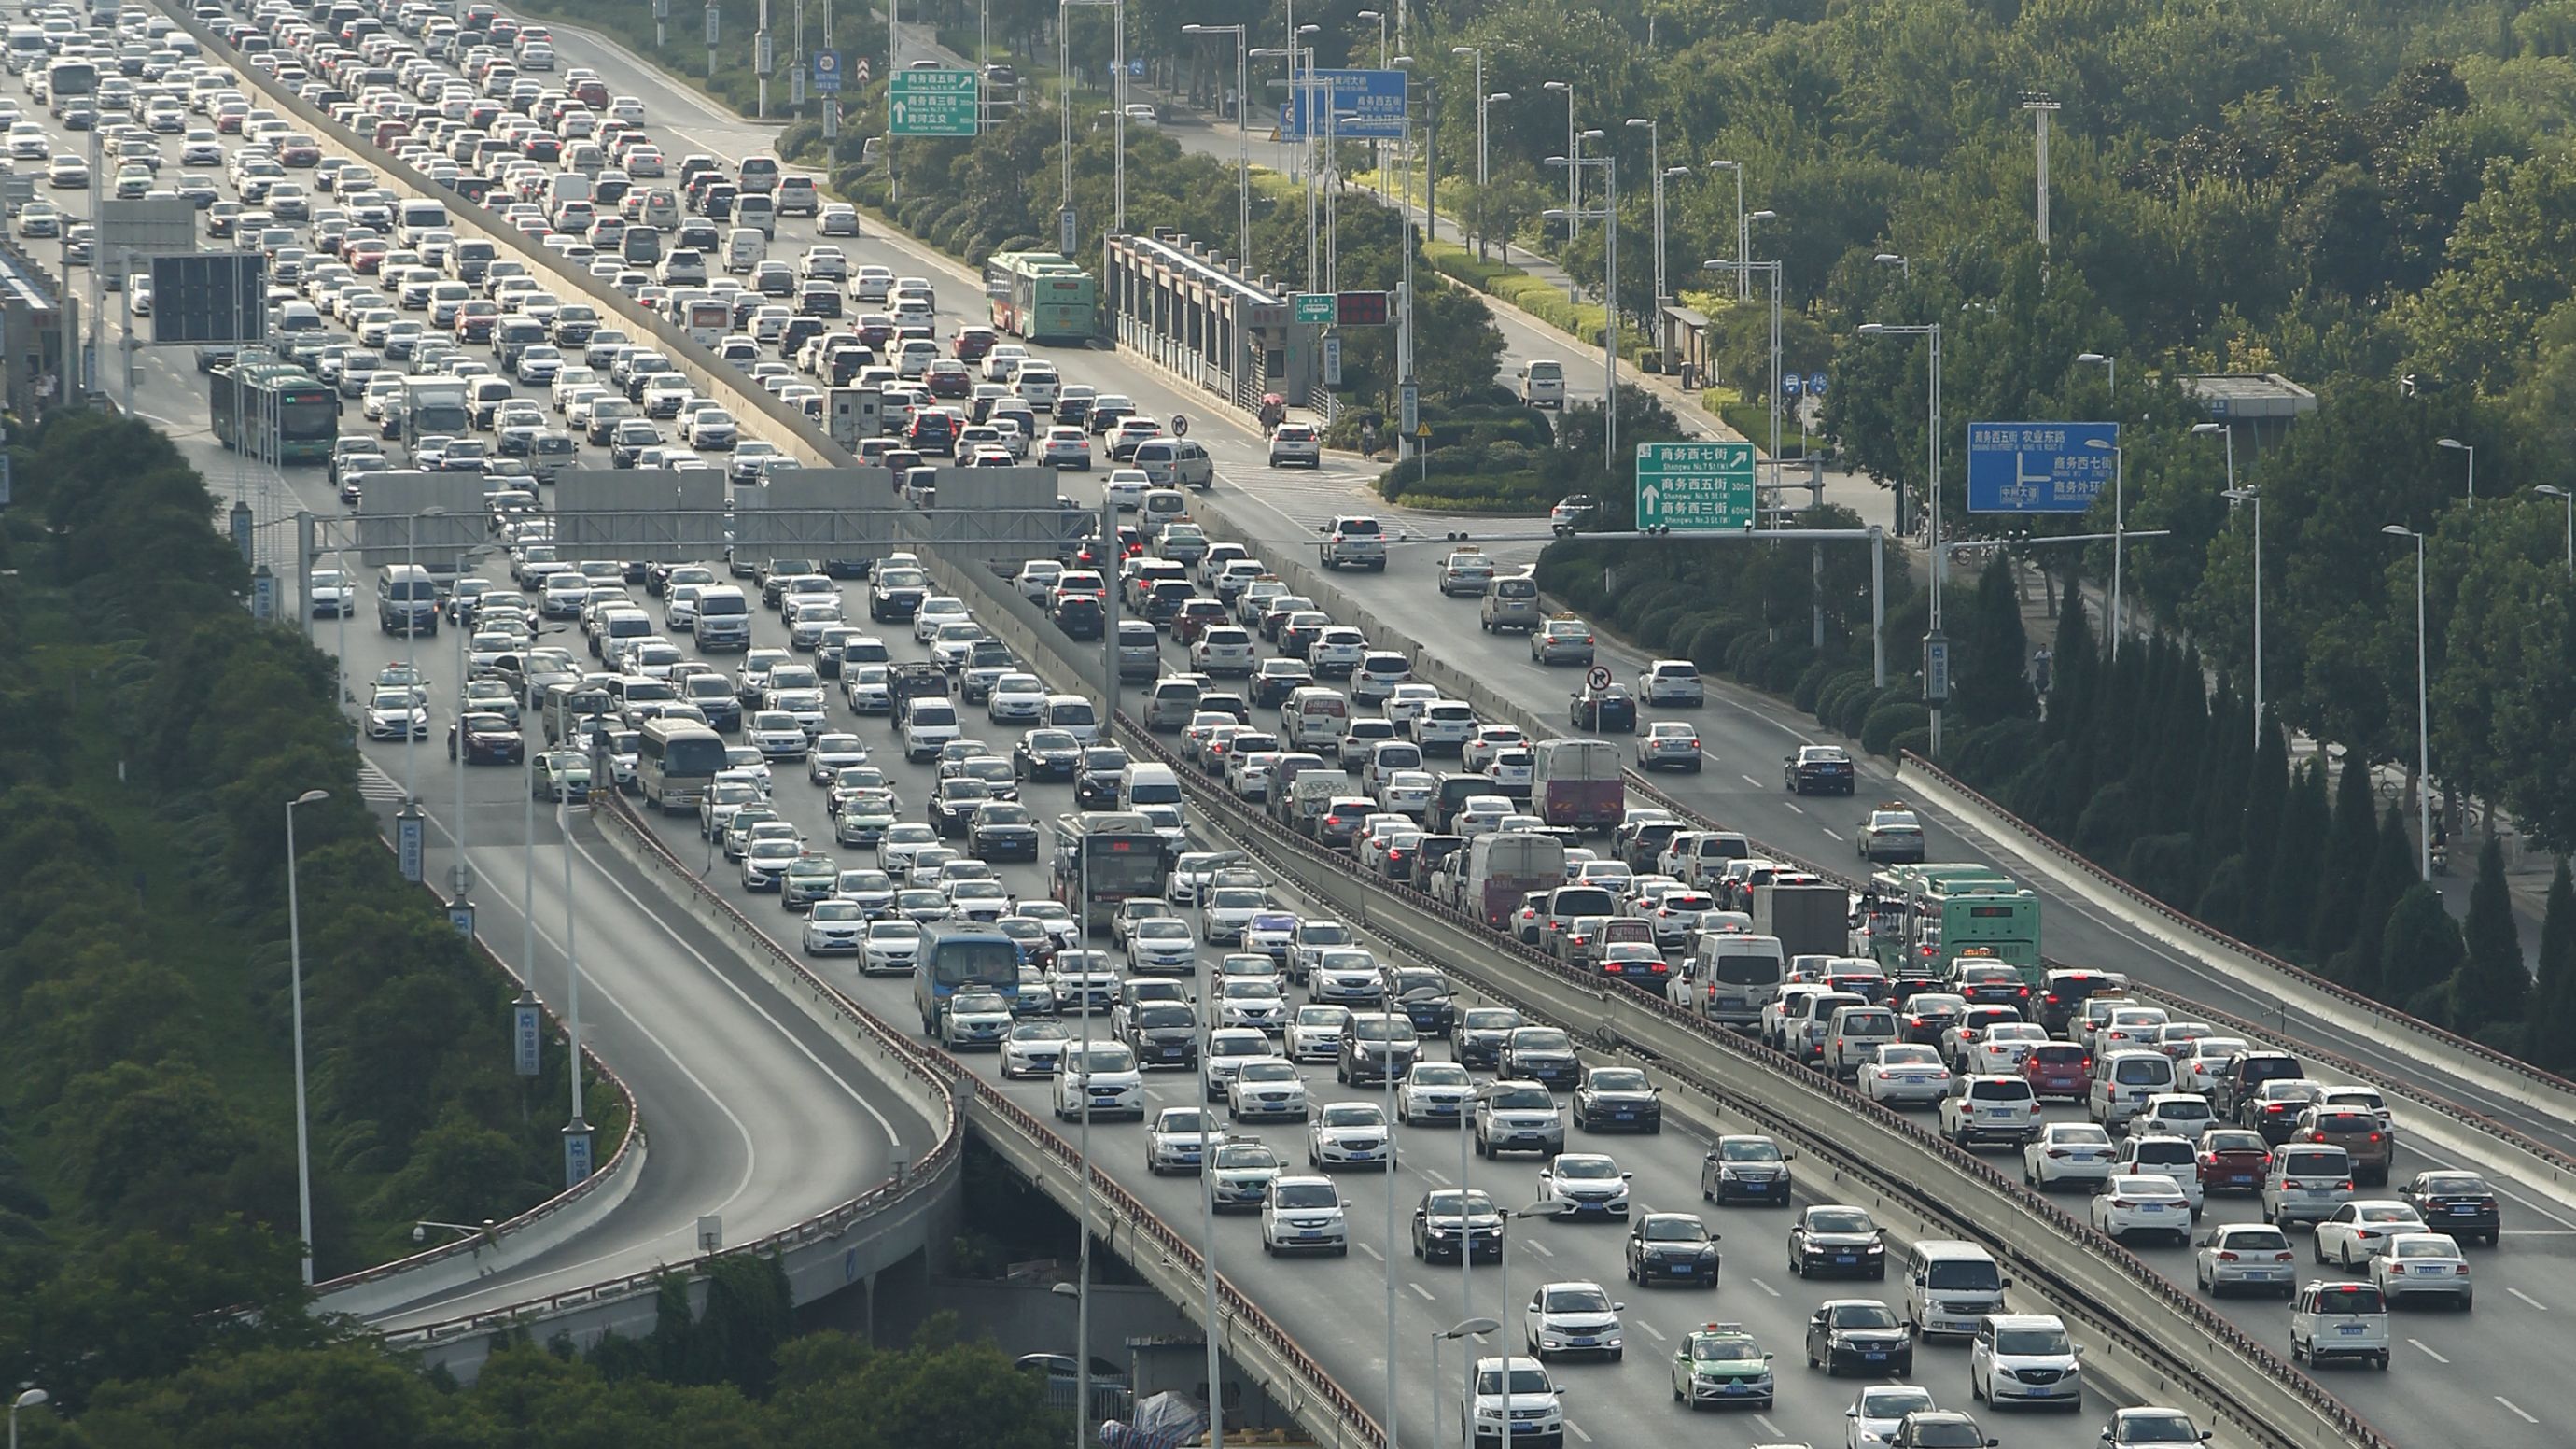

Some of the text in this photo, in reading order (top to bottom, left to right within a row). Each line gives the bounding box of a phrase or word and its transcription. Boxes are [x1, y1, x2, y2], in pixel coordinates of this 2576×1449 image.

[1974, 430, 2065, 443] 商务西五街 农业东路
[1661, 448, 1728, 461] 商务西七街
[2054, 456, 2112, 470] 商务西七街
[1661, 478, 1728, 490] 商务西五街
[2054, 481, 2107, 494] 商务外环
[1661, 502, 1727, 514] 商务西三街
